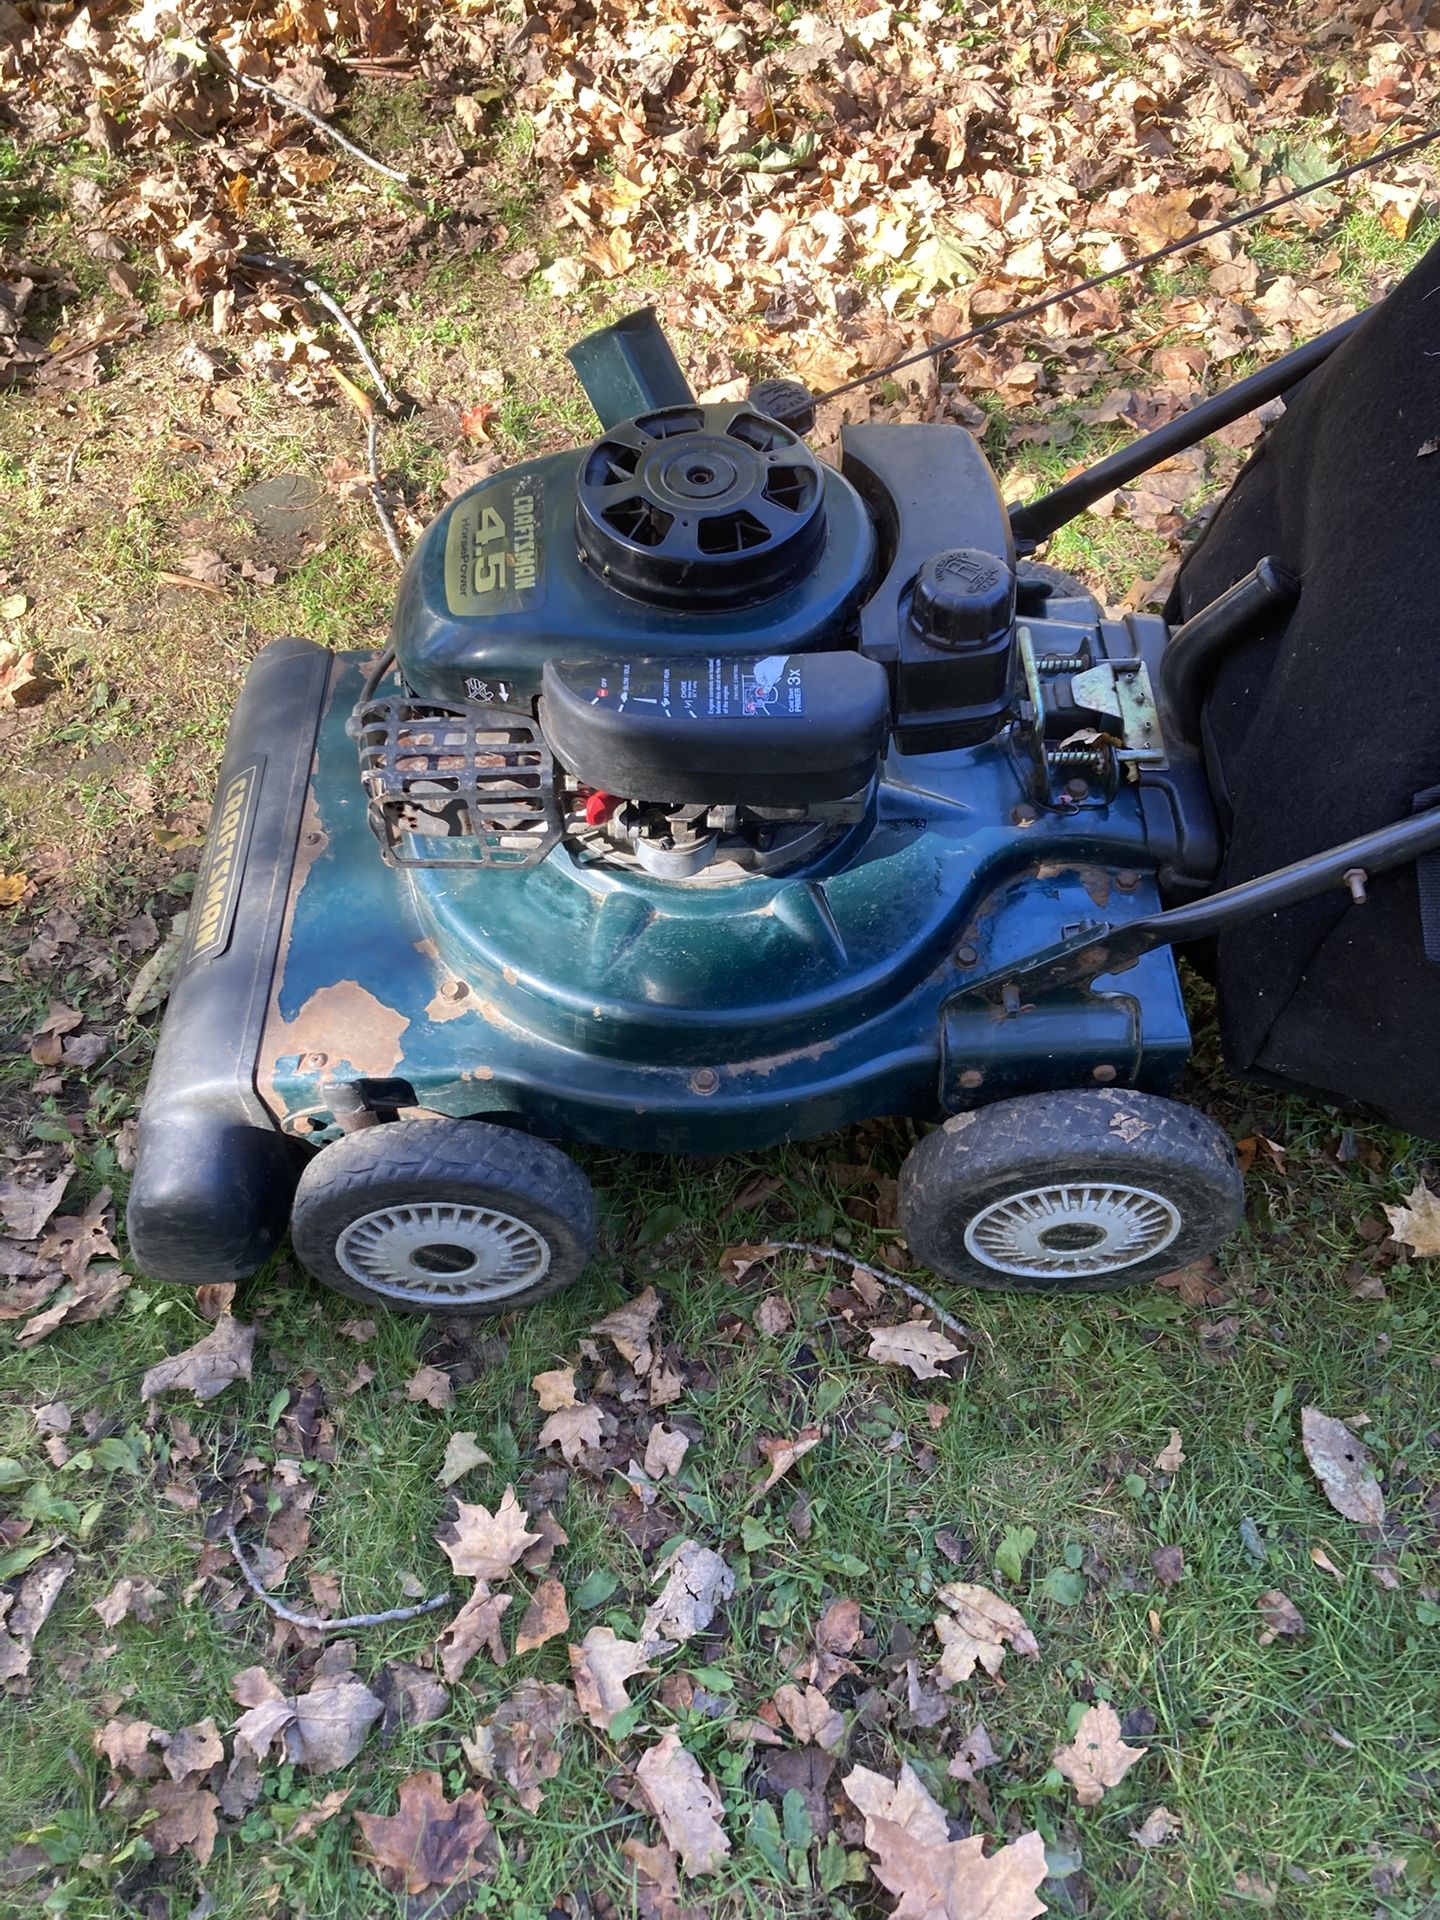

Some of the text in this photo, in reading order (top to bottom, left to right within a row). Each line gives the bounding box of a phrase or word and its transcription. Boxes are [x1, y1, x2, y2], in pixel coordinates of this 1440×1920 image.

[460, 517, 471, 596] HorsePower
[475, 507, 505, 593] 4.5
[514, 495, 536, 590] CRAFTSMAN
[194, 777, 247, 951] CRAFTSMAN
